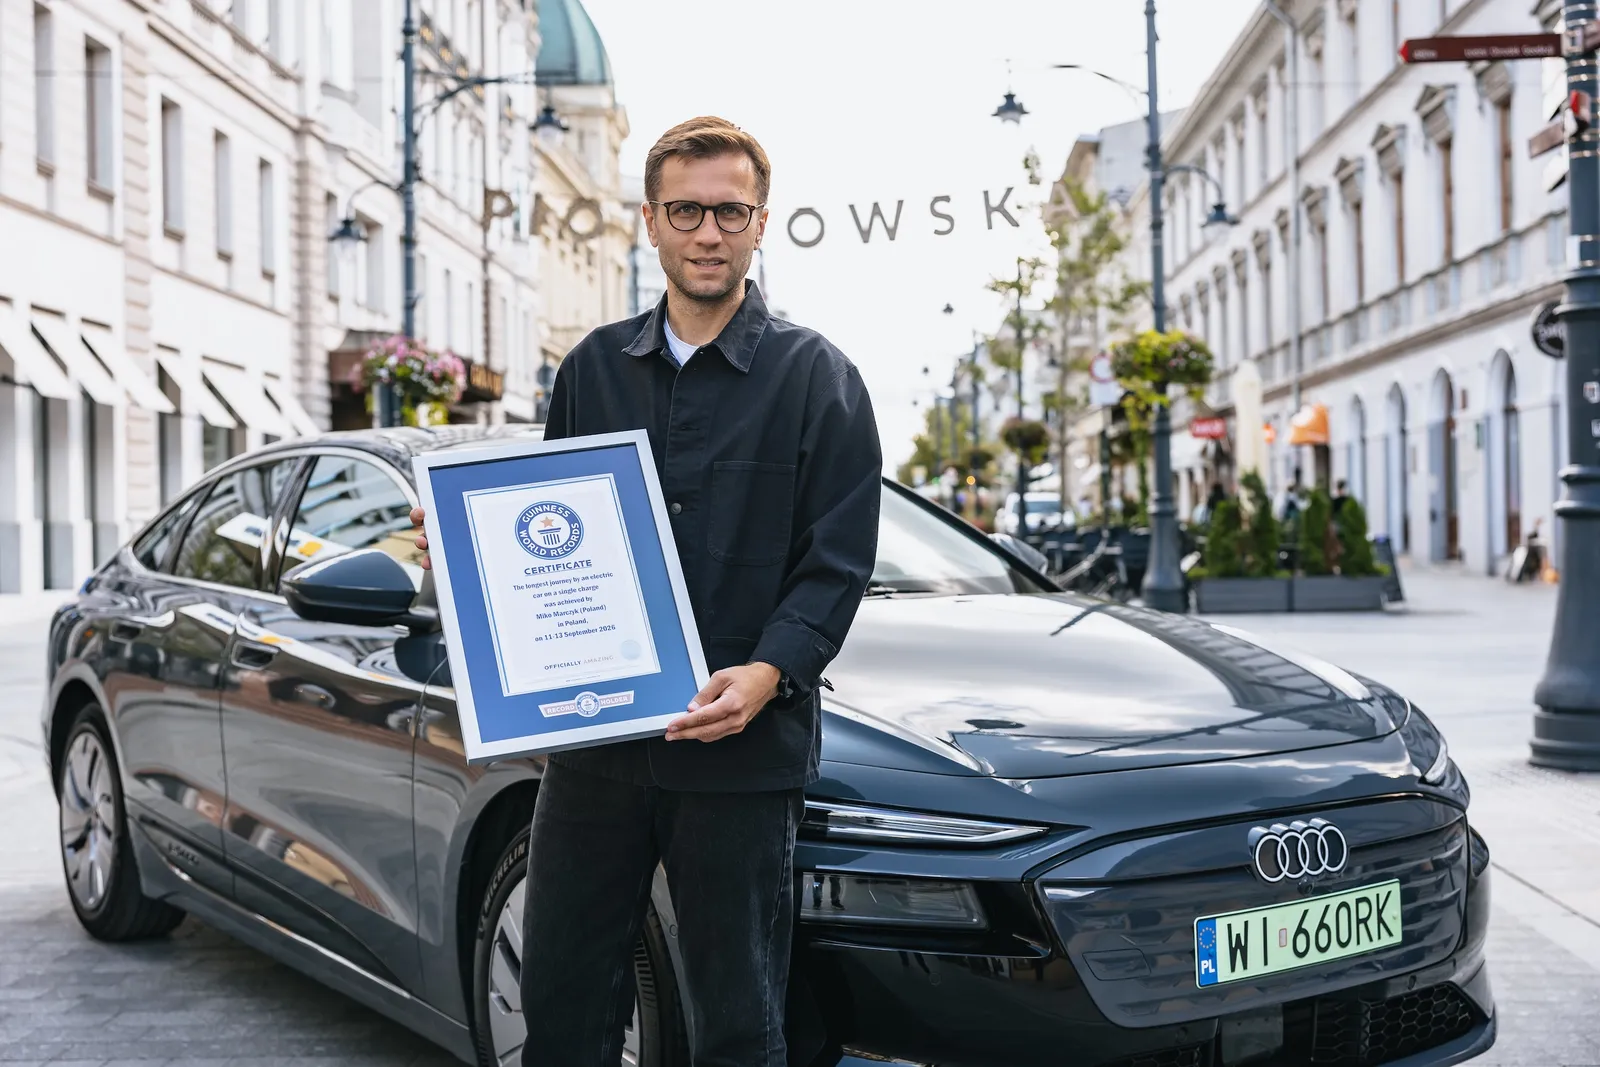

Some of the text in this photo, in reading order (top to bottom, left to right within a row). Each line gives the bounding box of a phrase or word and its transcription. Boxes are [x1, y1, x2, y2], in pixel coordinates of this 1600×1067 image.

[522, 504, 570, 522] GUINNESS
[520, 522, 580, 556] WORLD RECORDS
[524, 560, 592, 575] CERTIFICATE
[550, 579, 572, 587] journey
[578, 584, 599, 592] charge
[558, 597, 584, 606] achieved
[553, 608, 579, 617] Marczyk
[580, 604, 606, 614] (Poland)
[564, 628, 598, 638] September
[544, 655, 614, 670] OFFICIALLY AMAZING
[547, 696, 628, 714] RECORD HOLDER
[1226, 890, 1394, 973] WI 660RK
[1201, 959, 1215, 974] PL
